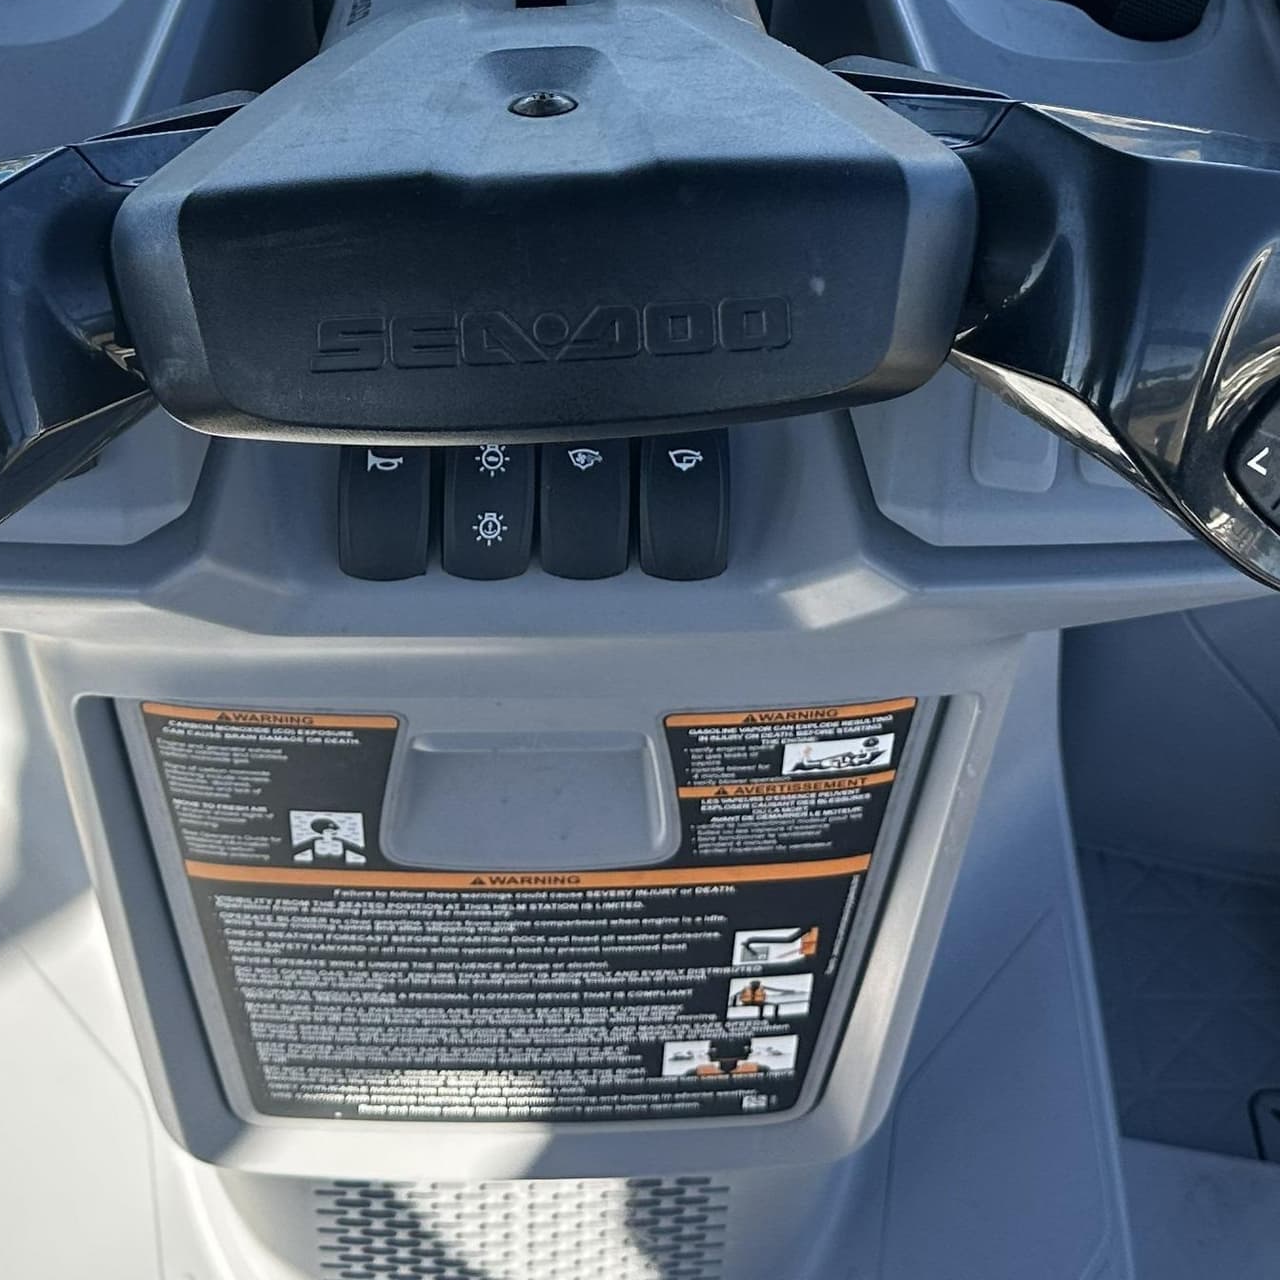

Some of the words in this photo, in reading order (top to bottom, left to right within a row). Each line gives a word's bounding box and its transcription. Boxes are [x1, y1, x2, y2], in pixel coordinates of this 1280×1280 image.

[231, 712, 314, 725] WARNING
[759, 708, 838, 721] WARNING
[168, 719, 213, 730] CARBON
[215, 724, 271, 734] MONOXIDE
[297, 728, 354, 737] EXPOSURE
[689, 726, 737, 735] GASOLINE
[739, 724, 773, 734] VAPOR
[775, 723, 794, 732] CAN
[795, 720, 839, 730] EXPLODE
[841, 714, 893, 728] RESULTING
[795, 726, 835, 737] BEFORE
[836, 723, 882, 734] STARTING
[162, 726, 186, 736] CAN
[187, 729, 222, 739] CAUSE
[258, 733, 304, 743] DAMAGE
[306, 736, 322, 744] OR
[736, 776, 868, 795] AVERTISSEMENT
[488, 876, 581, 885] WARNING
[460, 891, 513, 901] warnings
[515, 890, 548, 899] could
[549, 890, 583, 899] cause
[635, 886, 677, 897] INJURY
[387, 902, 443, 910] POSITION
[528, 902, 579, 911] STATION
[224, 927, 264, 936] CHECK
[266, 930, 324, 940] WEATHER
[325, 933, 389, 943] FORECAST
[390, 934, 440, 943] BEFORE
[441, 934, 509, 943] DEPARTING
[511, 935, 546, 943] DOCK
[368, 960, 410, 969] UNDER
[411, 961, 434, 969] THE
[435, 961, 501, 969] INFLUENCE
[537, 991, 580, 1000] DEVICE
[583, 990, 612, 1000] THAT
[626, 987, 693, 998] COMPLIANT
